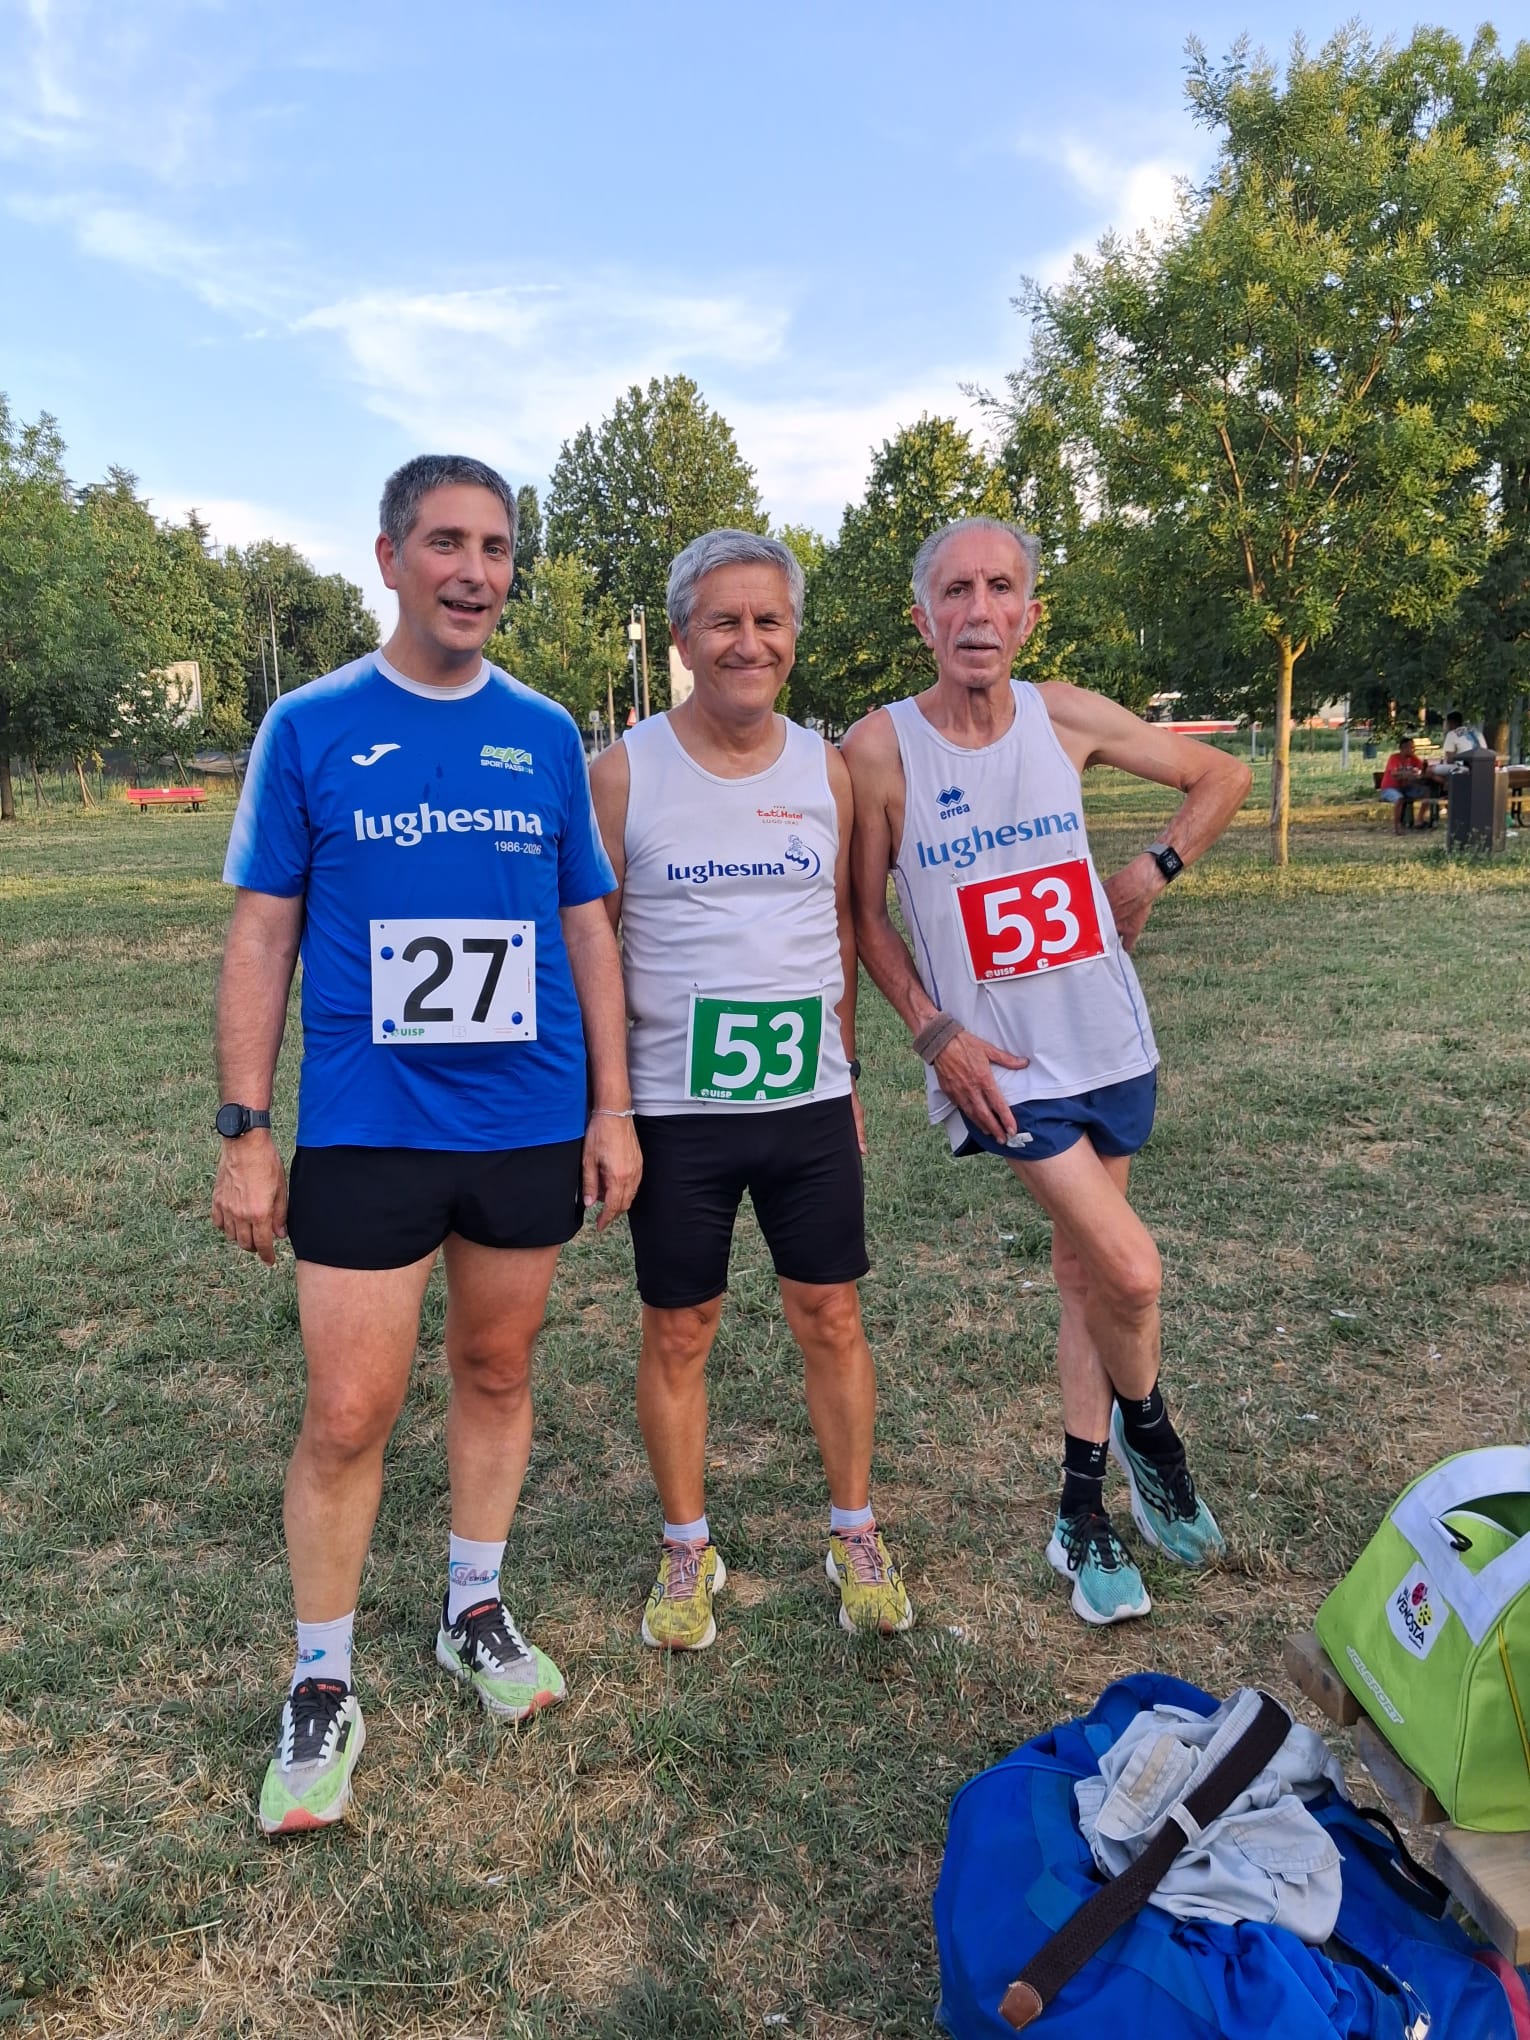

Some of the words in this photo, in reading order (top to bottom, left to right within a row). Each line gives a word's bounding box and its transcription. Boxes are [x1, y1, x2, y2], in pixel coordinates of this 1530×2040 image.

[480, 744, 533, 765] DEKA
[480, 759, 503, 769] SPORT
[939, 803, 971, 820] errea
[353, 803, 544, 847] lughesina
[916, 811, 1079, 869] lughesina
[667, 860, 785, 884] lughesina
[983, 876, 1081, 966] 53
[401, 936, 509, 1023] 27
[994, 966, 1016, 977] UISP
[401, 1028, 425, 1036] UISP
[711, 1011, 805, 1089] 53
[710, 1090, 733, 1099] UISP
[1395, 1593, 1425, 1646] VENOSTA
